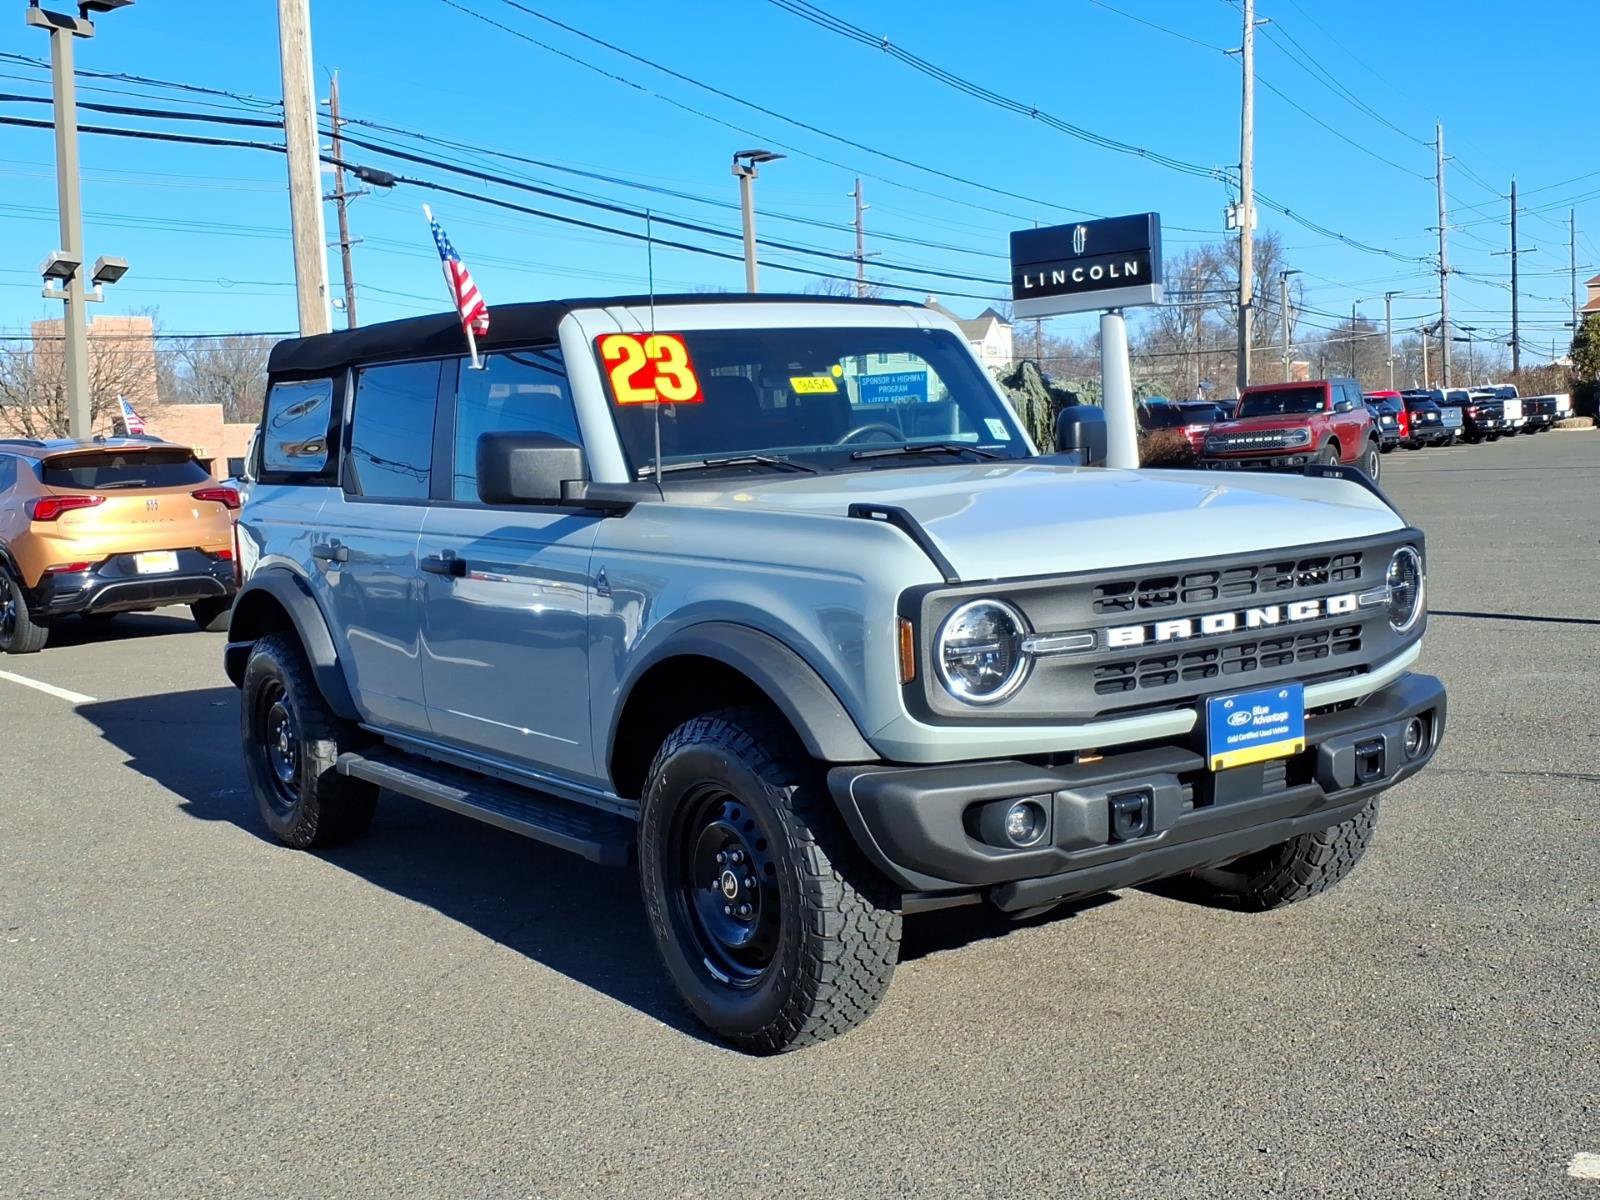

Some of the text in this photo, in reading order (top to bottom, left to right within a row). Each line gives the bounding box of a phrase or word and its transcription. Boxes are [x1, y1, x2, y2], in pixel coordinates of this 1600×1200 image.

[1023, 261, 1138, 288] LINCOLN
[602, 334, 698, 403] 23
[862, 376, 890, 385] SPONSOR
[897, 374, 925, 383] HIGHWAY
[879, 385, 908, 393] PROGRAM
[1106, 593, 1357, 648] BRONCO
[1252, 706, 1270, 716] Blue
[1252, 712, 1289, 725] Advantage
[1227, 735, 1239, 743] Gold
[1259, 729, 1272, 737] Used
[1273, 726, 1289, 735] Vehicle
